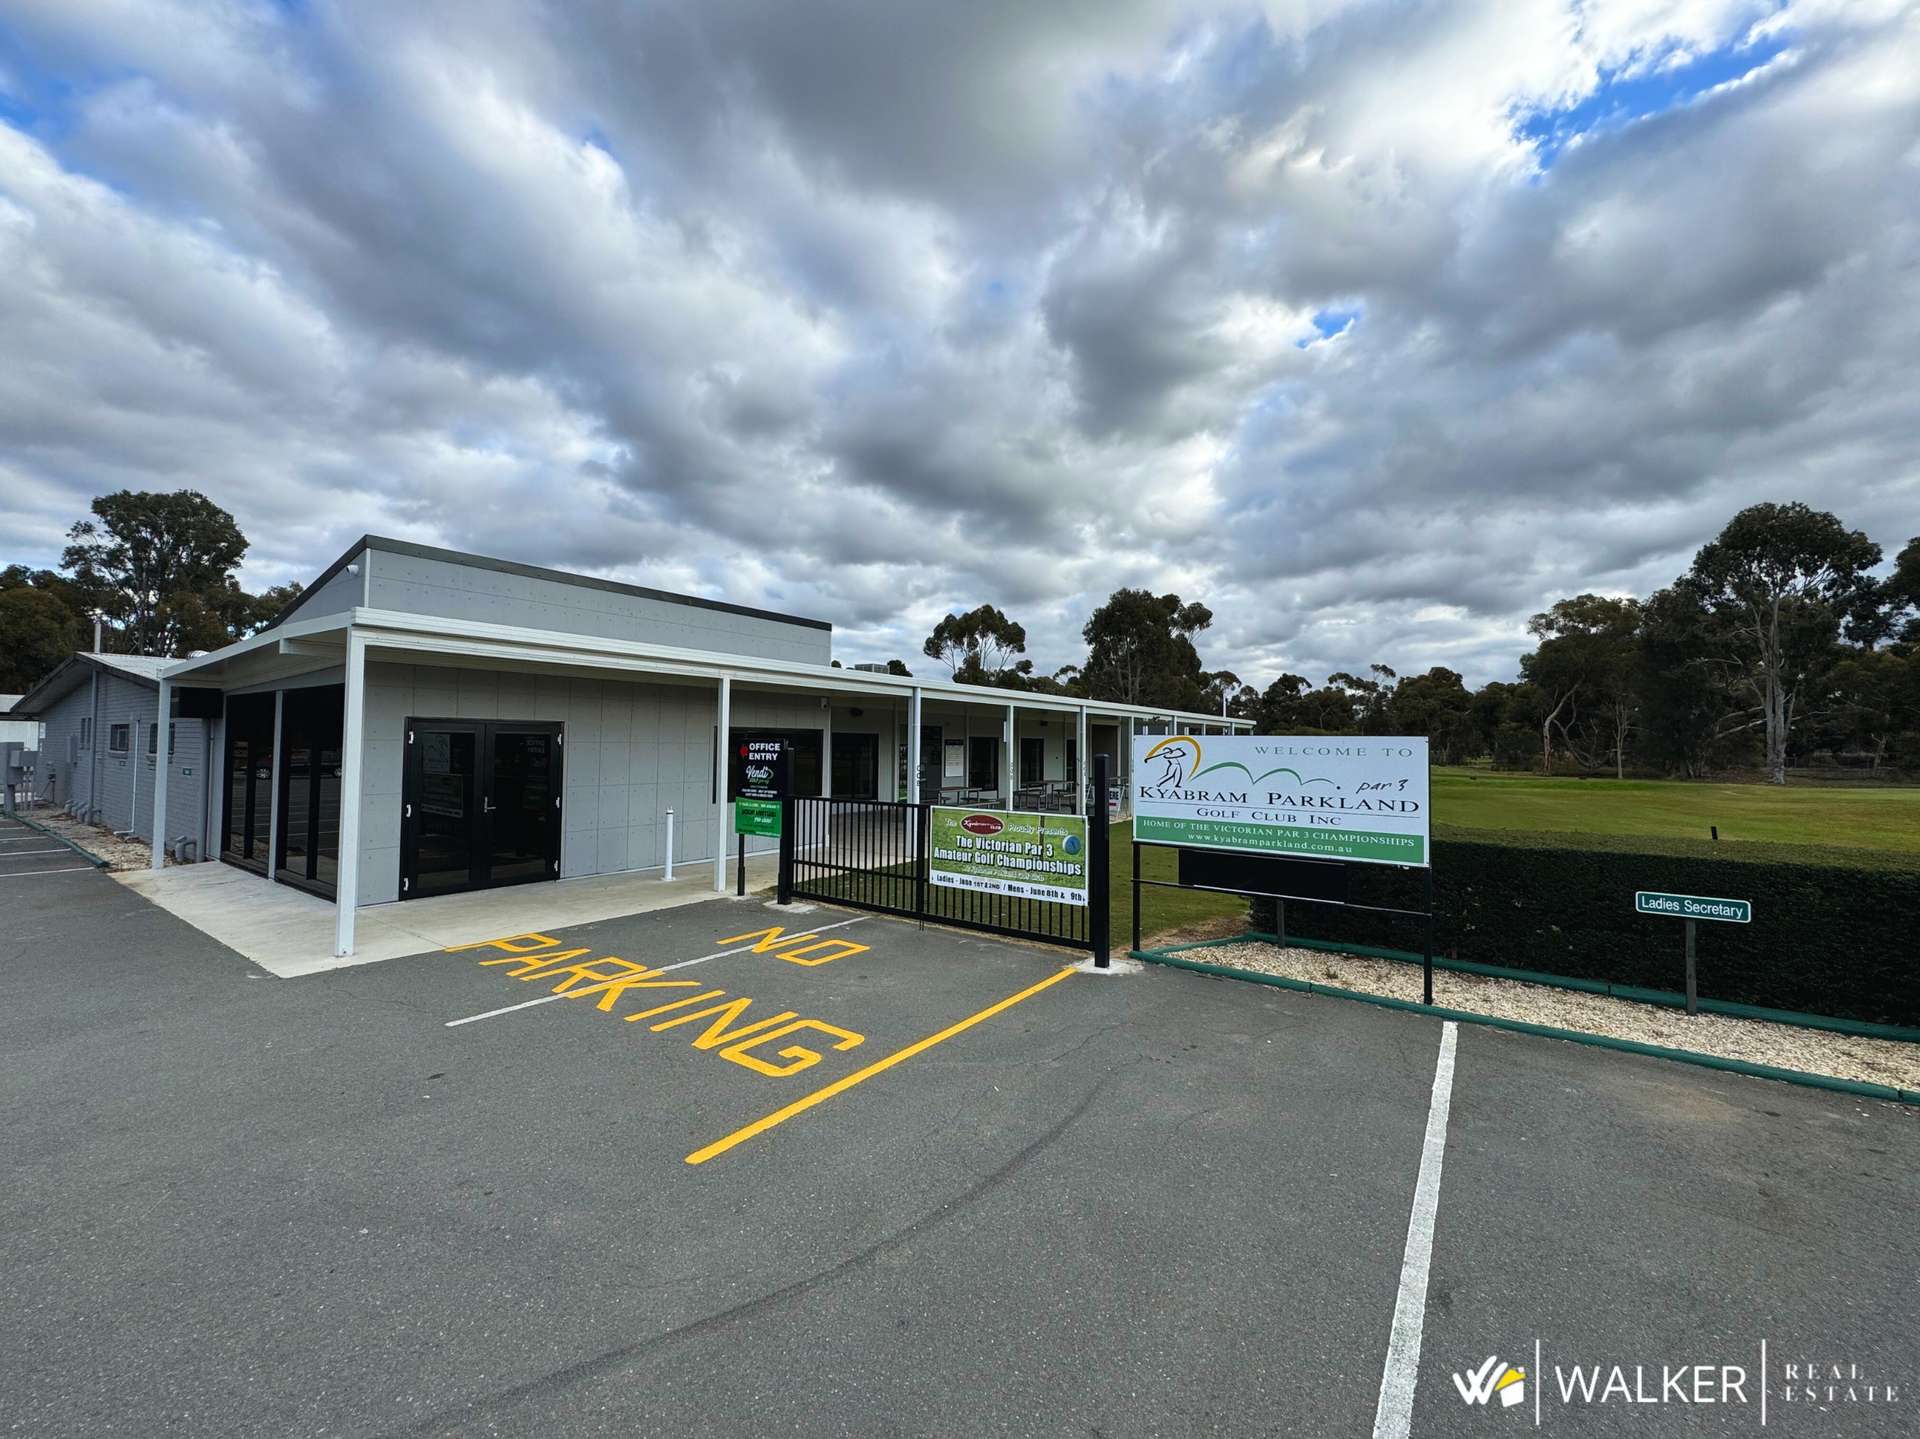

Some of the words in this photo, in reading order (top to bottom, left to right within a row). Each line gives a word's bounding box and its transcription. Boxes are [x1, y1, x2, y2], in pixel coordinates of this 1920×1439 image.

[748, 743, 781, 751] OFFICE
[748, 753, 778, 761] ENTRY
[1255, 746, 1368, 757] WELCOME
[1385, 749, 1413, 758] TO
[1356, 781, 1392, 794] par
[1396, 778, 1409, 792] 3
[1139, 786, 1248, 804] KYABRAM
[1268, 792, 1420, 813] PARKLAND
[1196, 807, 1240, 819] GOLF
[1251, 811, 1297, 823] CLUB
[1310, 814, 1342, 826] INC
[1143, 820, 1170, 828] HOME
[1191, 823, 1210, 831] THE
[1214, 825, 1273, 836] VICTORIAN
[1277, 829, 1300, 838] PAR
[1304, 831, 1309, 839] 3
[1313, 832, 1415, 847] CHAMPIONSHIPS
[1188, 833, 1352, 853] www.kyabramparkland.com.au
[956, 835, 973, 849] The
[975, 837, 1022, 853] Victorian
[1025, 842, 1043, 856] Par
[1046, 844, 1053, 857] 3
[934, 847, 973, 863] Amateur
[974, 851, 995, 866] Golf
[996, 854, 1081, 875] Championships
[936, 874, 954, 883] Ladies
[1008, 884, 1025, 893] Mens
[1030, 887, 1045, 896] June
[1071, 892, 1082, 901] 9th
[1642, 895, 1680, 911] Ladies
[1684, 899, 1743, 919] Secretary
[717, 926, 871, 967] NO
[445, 933, 865, 1077] PARKING
